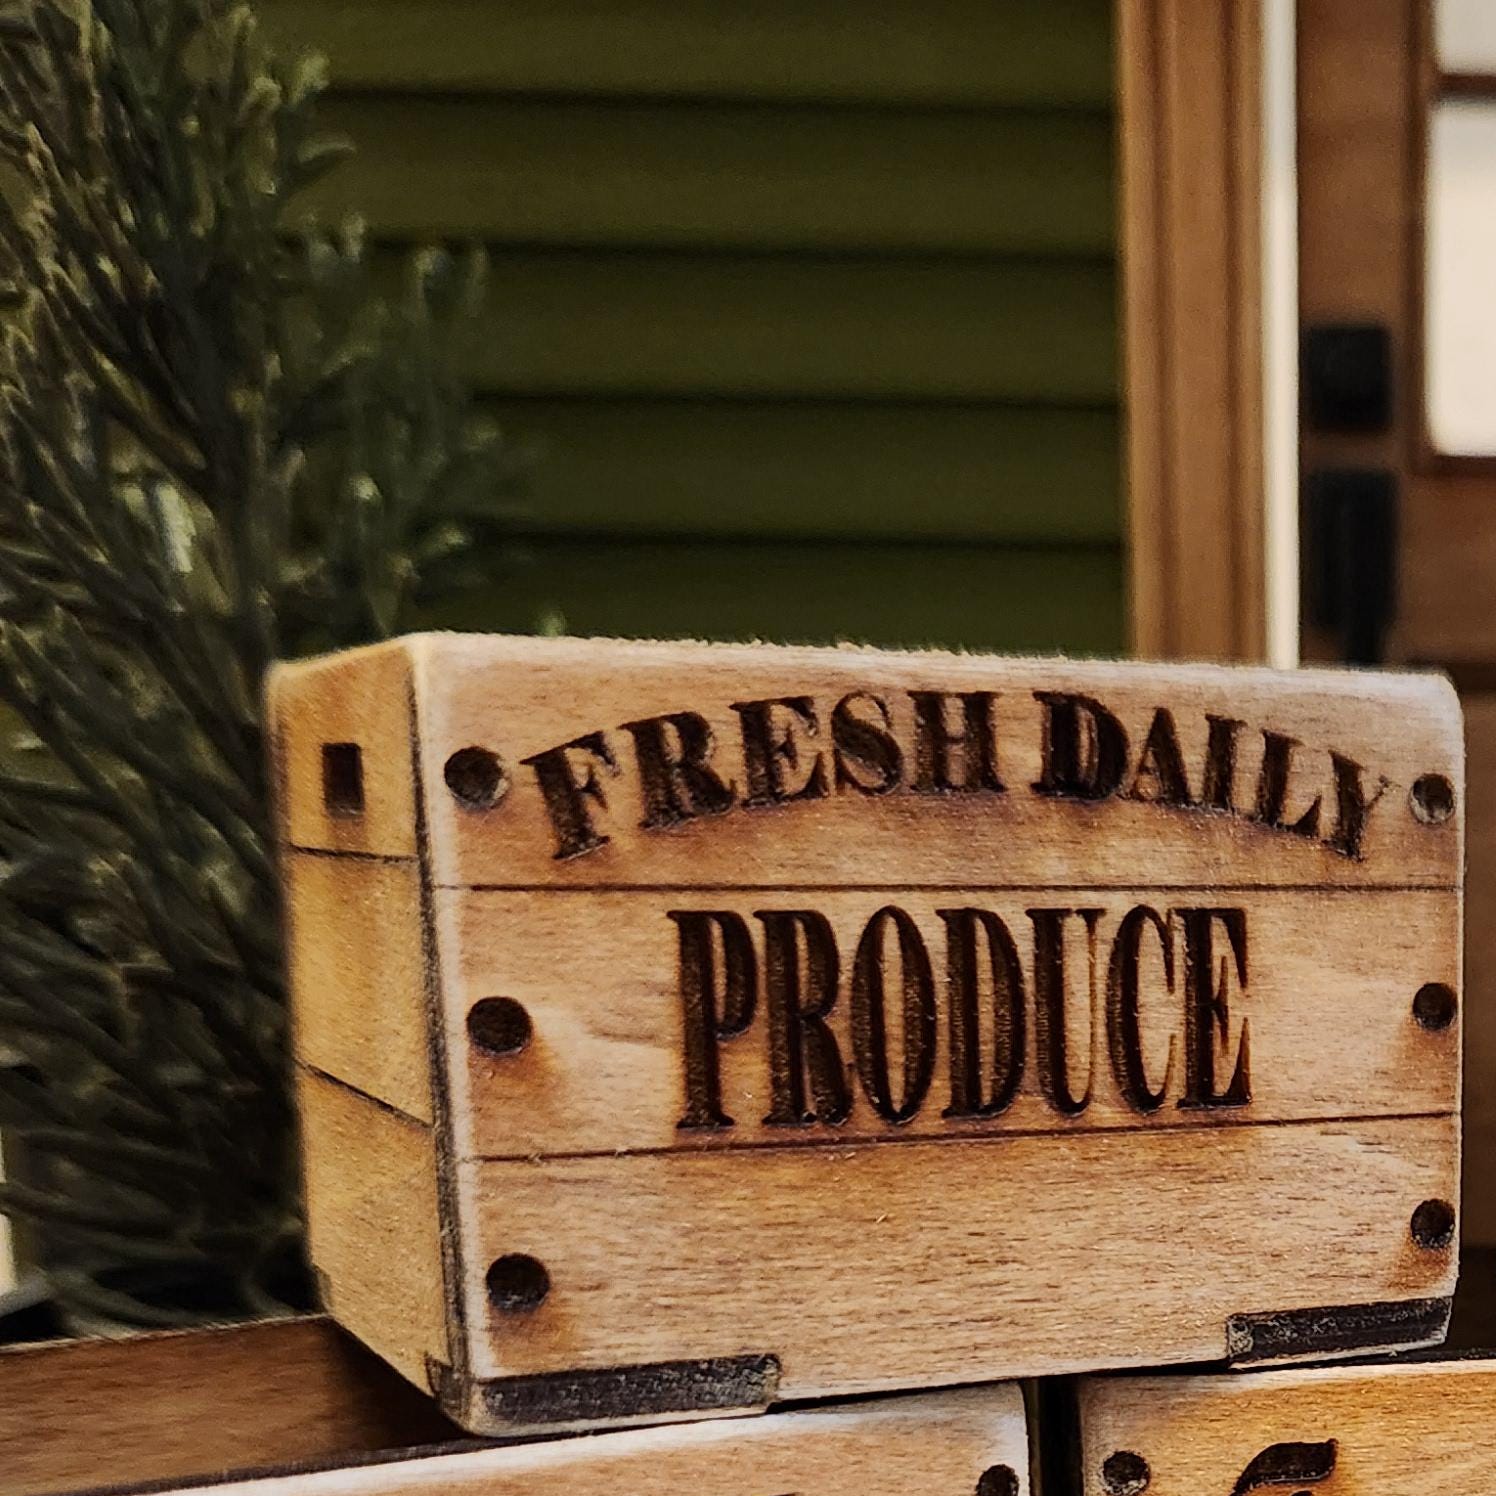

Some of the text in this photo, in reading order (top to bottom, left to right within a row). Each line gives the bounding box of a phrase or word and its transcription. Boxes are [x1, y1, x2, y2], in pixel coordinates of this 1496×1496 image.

[520, 690, 1401, 862] FRESH DAILY
[666, 904, 1252, 1130] PRODUCE
